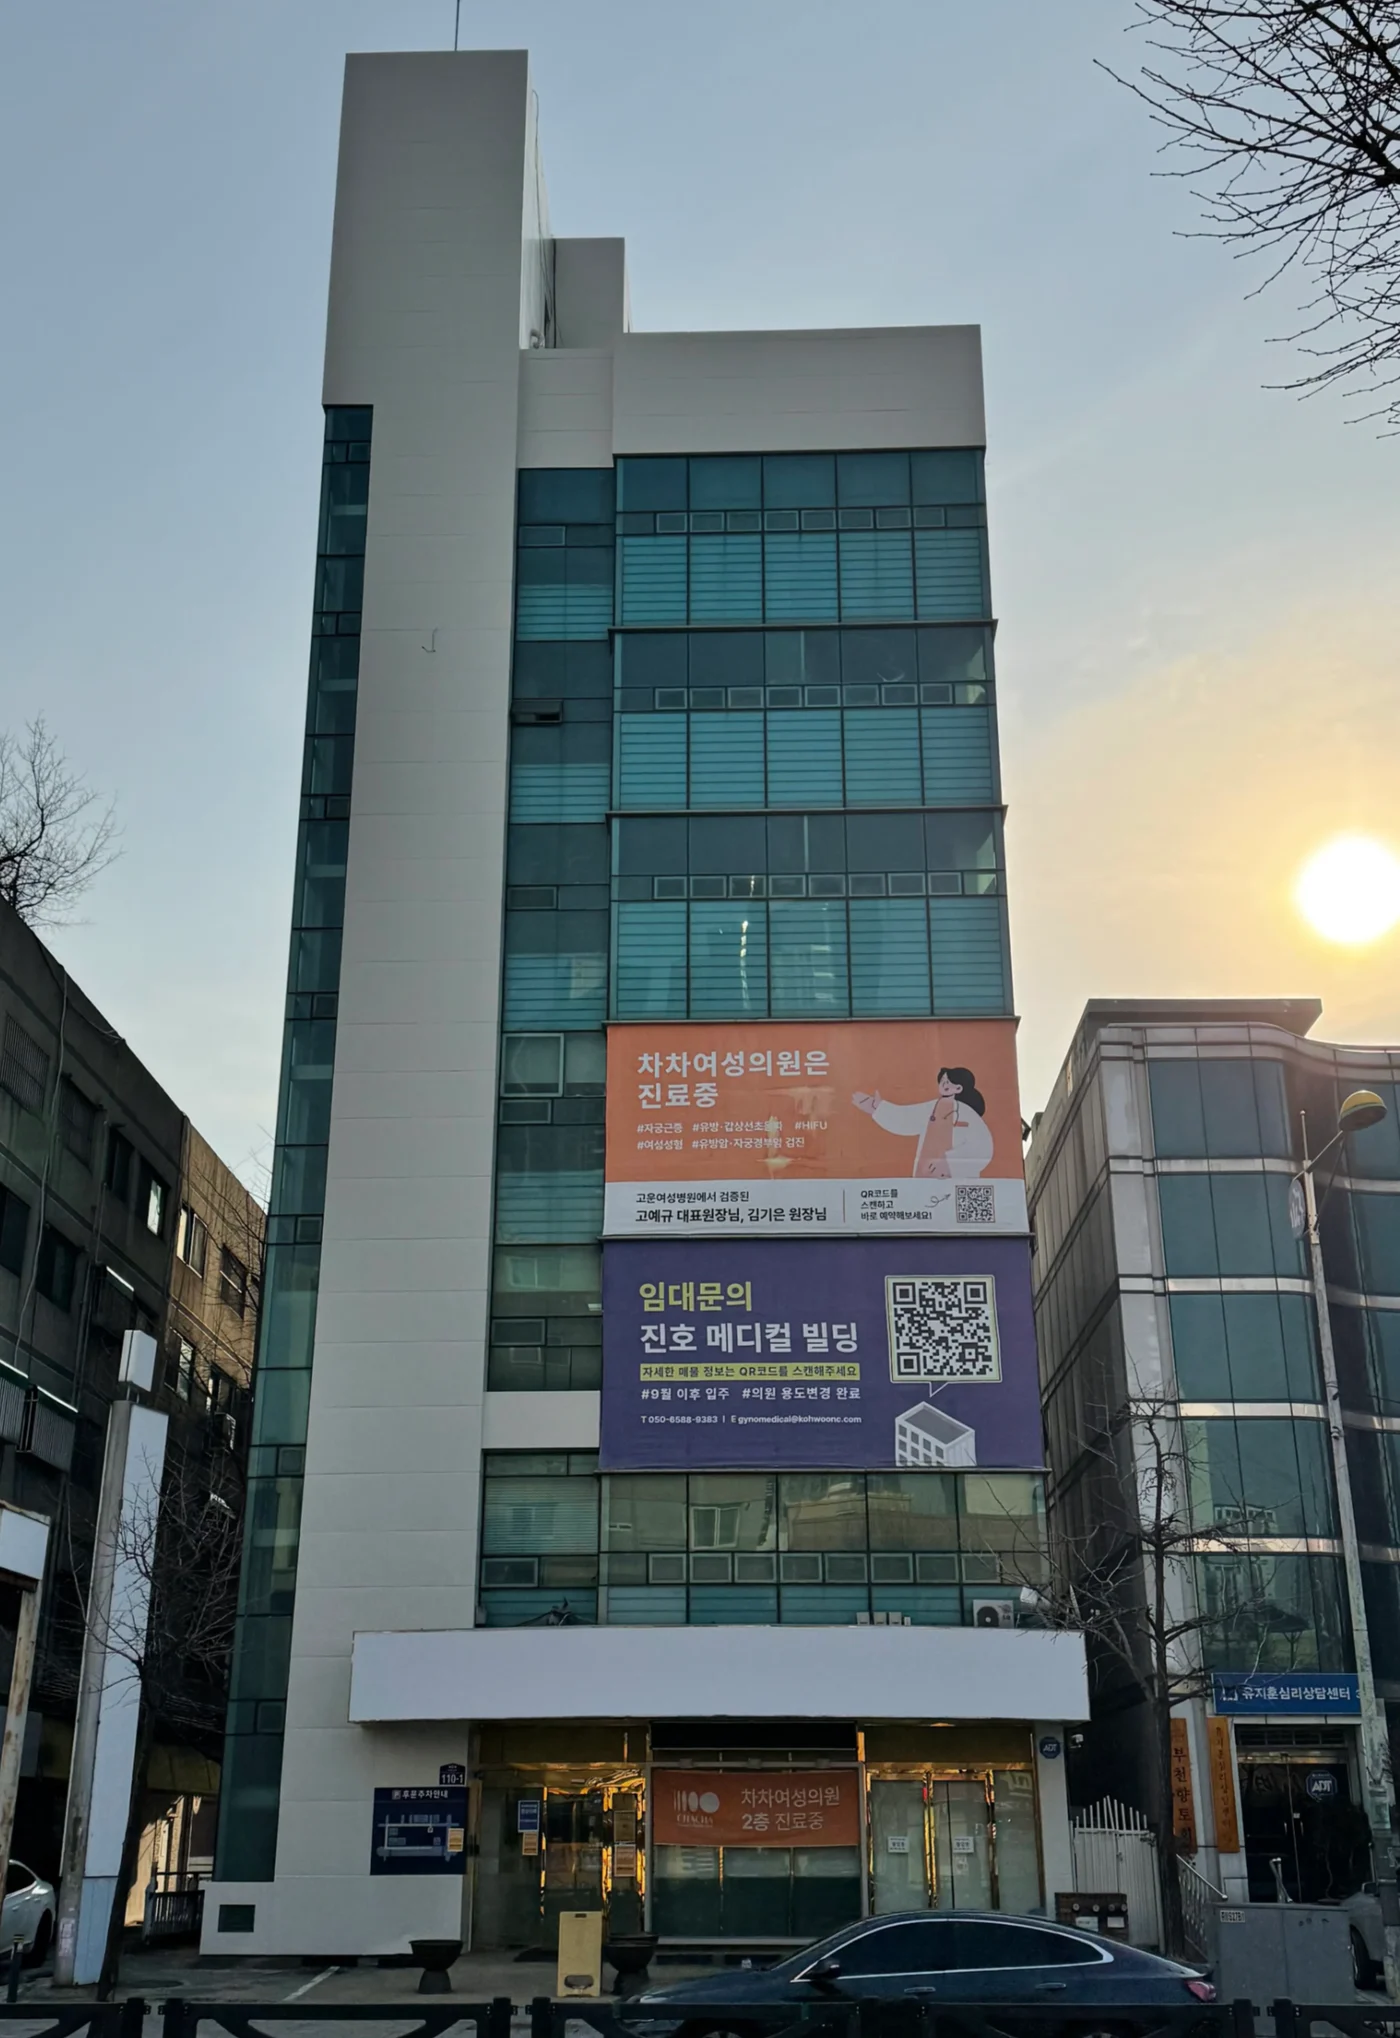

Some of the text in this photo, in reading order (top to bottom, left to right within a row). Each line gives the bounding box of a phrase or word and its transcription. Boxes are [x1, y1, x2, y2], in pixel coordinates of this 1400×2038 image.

[637, 1050, 830, 1078] 차차여성의원은
[638, 1082, 719, 1109] 진료중
[637, 1122, 683, 1134] #자궁근종
[795, 1120, 828, 1131] #HIFU
[637, 1139, 683, 1150] #여성성형
[785, 1137, 805, 1148] 검진
[636, 1191, 750, 1203] 고운여성병원에서 검증된
[860, 1188, 898, 1198] QR코드를
[635, 1207, 827, 1224] 고예규 대표원장님, 김기은 원장님
[860, 1210, 932, 1221] 바로 예약해보세요!
[639, 1281, 753, 1312] 임대문의
[640, 1322, 859, 1353] 진호 메디컬 빌딩
[642, 1365, 857, 1378] 자세한 매물 정보는 QR코드를 스캔해주세요
[641, 1387, 861, 1401] #9월 이후 입주 #의원 용도변경 완료
[648, 1415, 718, 1424] 050-6588-9383
[1241, 1686, 1351, 1701] 유지훈심리상담센터
[1043, 1743, 1058, 1752] ADT
[441, 1773, 463, 1784] 110-1
[1311, 1779, 1333, 1793] ADT
[402, 1789, 449, 1799] 후문주차안내
[741, 1785, 841, 1809] 차차여성의원
[741, 1811, 825, 1832] 2층 진료중
